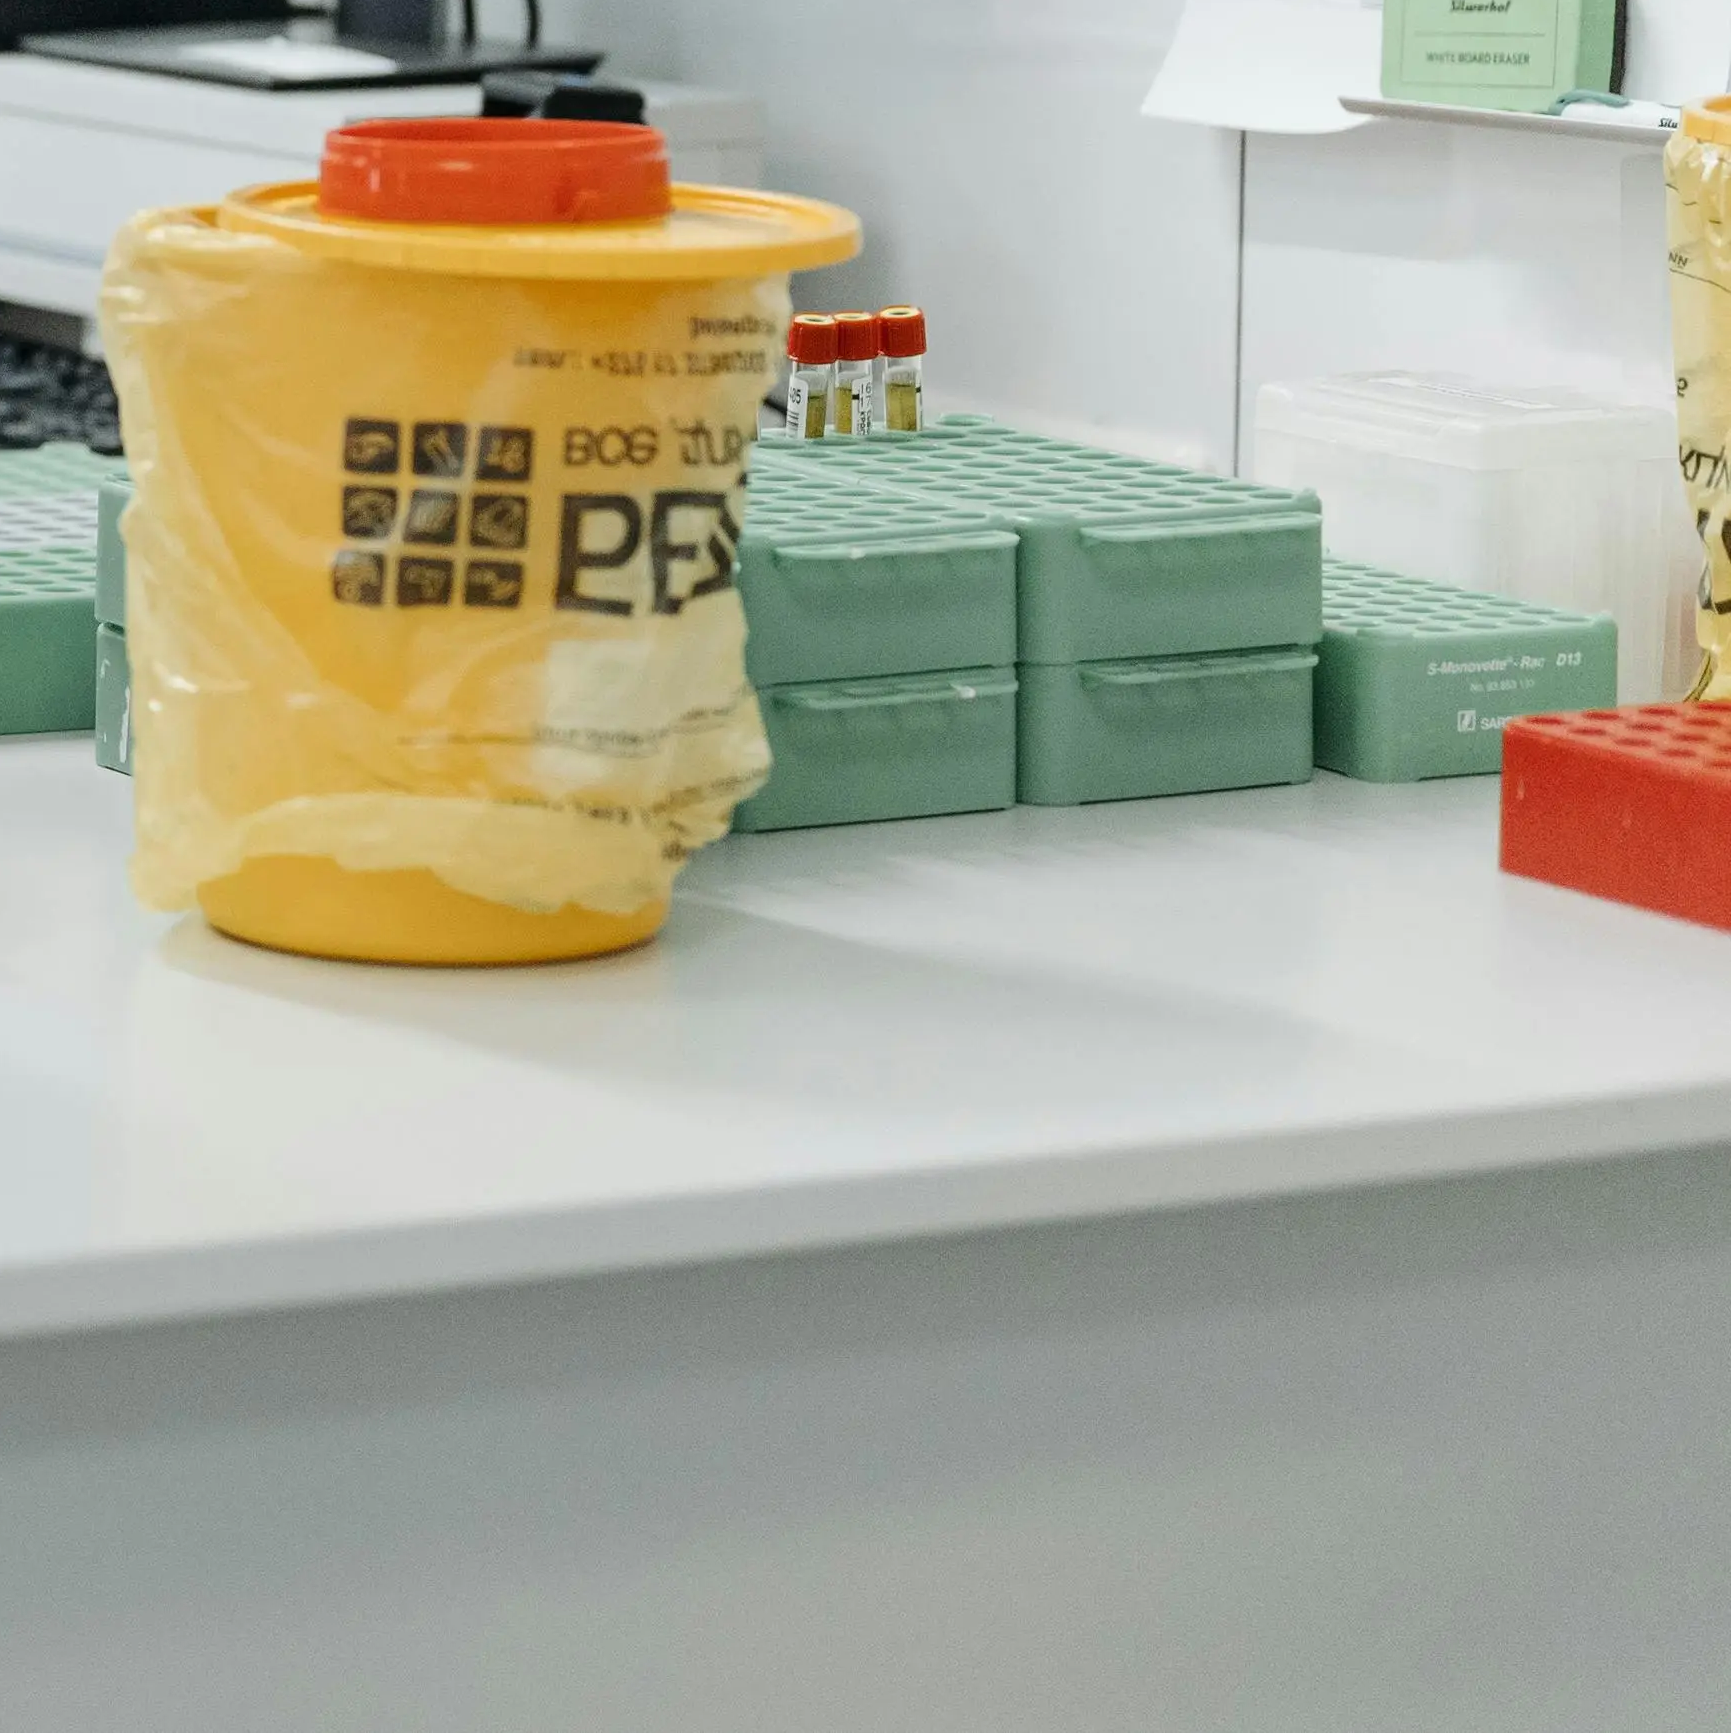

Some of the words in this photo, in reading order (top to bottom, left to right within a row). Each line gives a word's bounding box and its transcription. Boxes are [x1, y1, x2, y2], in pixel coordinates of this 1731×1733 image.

[1458, 52, 1491, 64] BOARD
[1492, 53, 1530, 65] ERASER
[1556, 652, 1582, 667] D13
